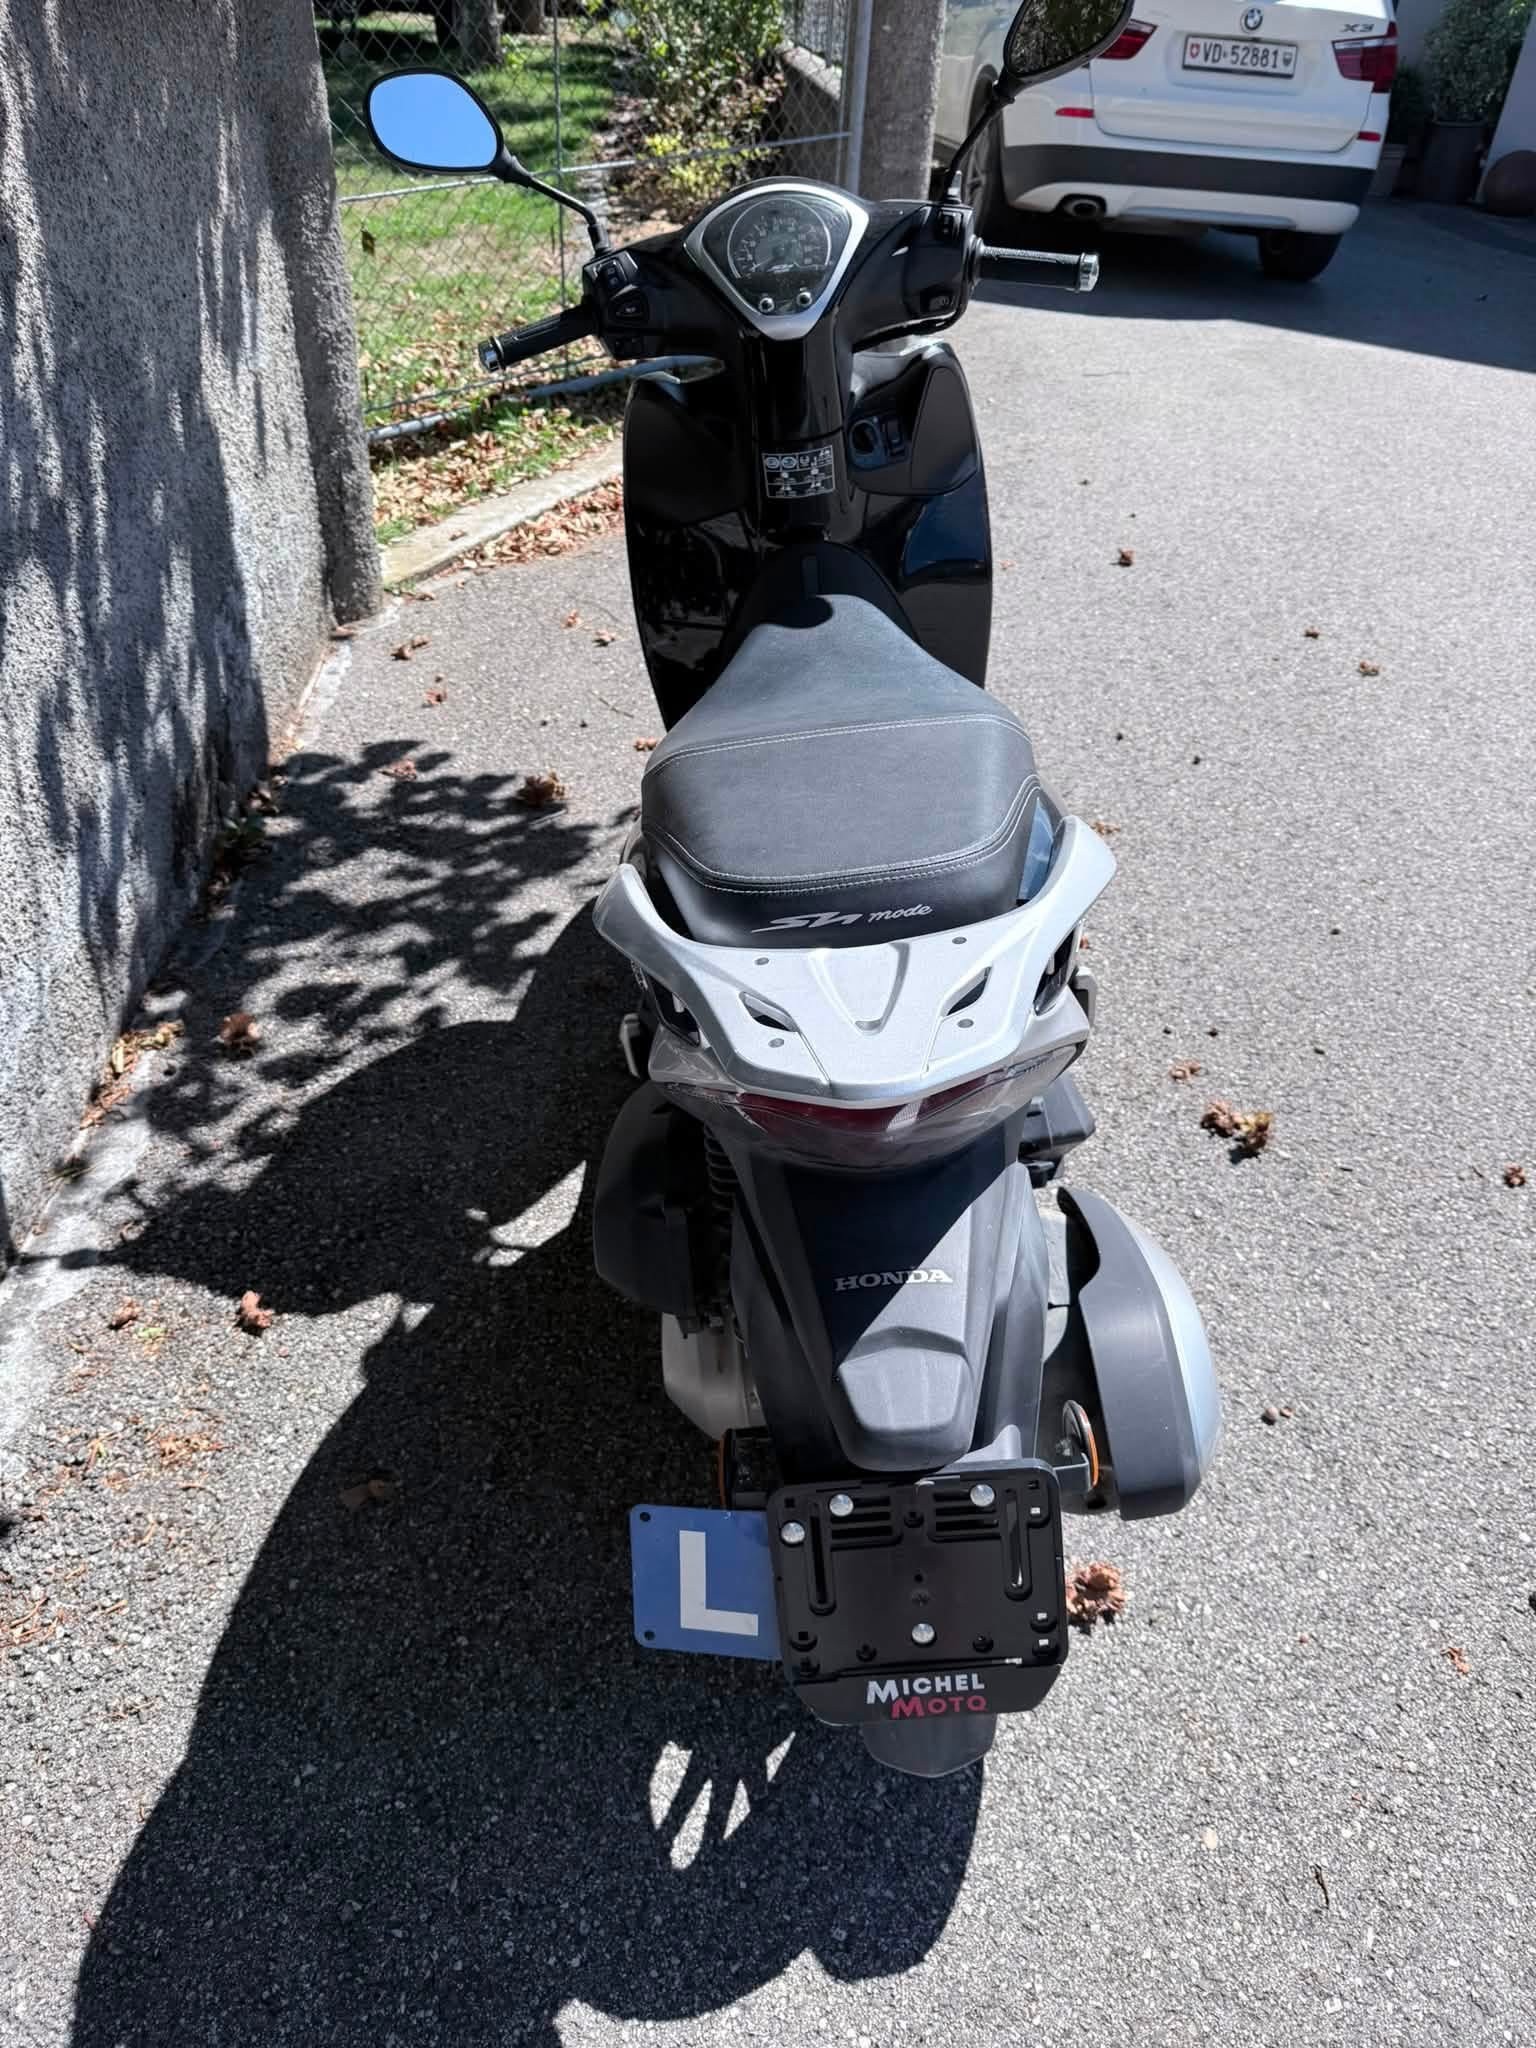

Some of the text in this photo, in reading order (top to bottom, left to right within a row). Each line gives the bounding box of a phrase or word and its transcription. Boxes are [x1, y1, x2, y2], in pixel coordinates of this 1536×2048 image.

[1340, 23, 1375, 33] X3
[868, 903, 934, 923] mode
[834, 1268, 953, 1292] HONDA
[679, 1530, 759, 1636] L
[866, 1673, 985, 1705] MICHEL
